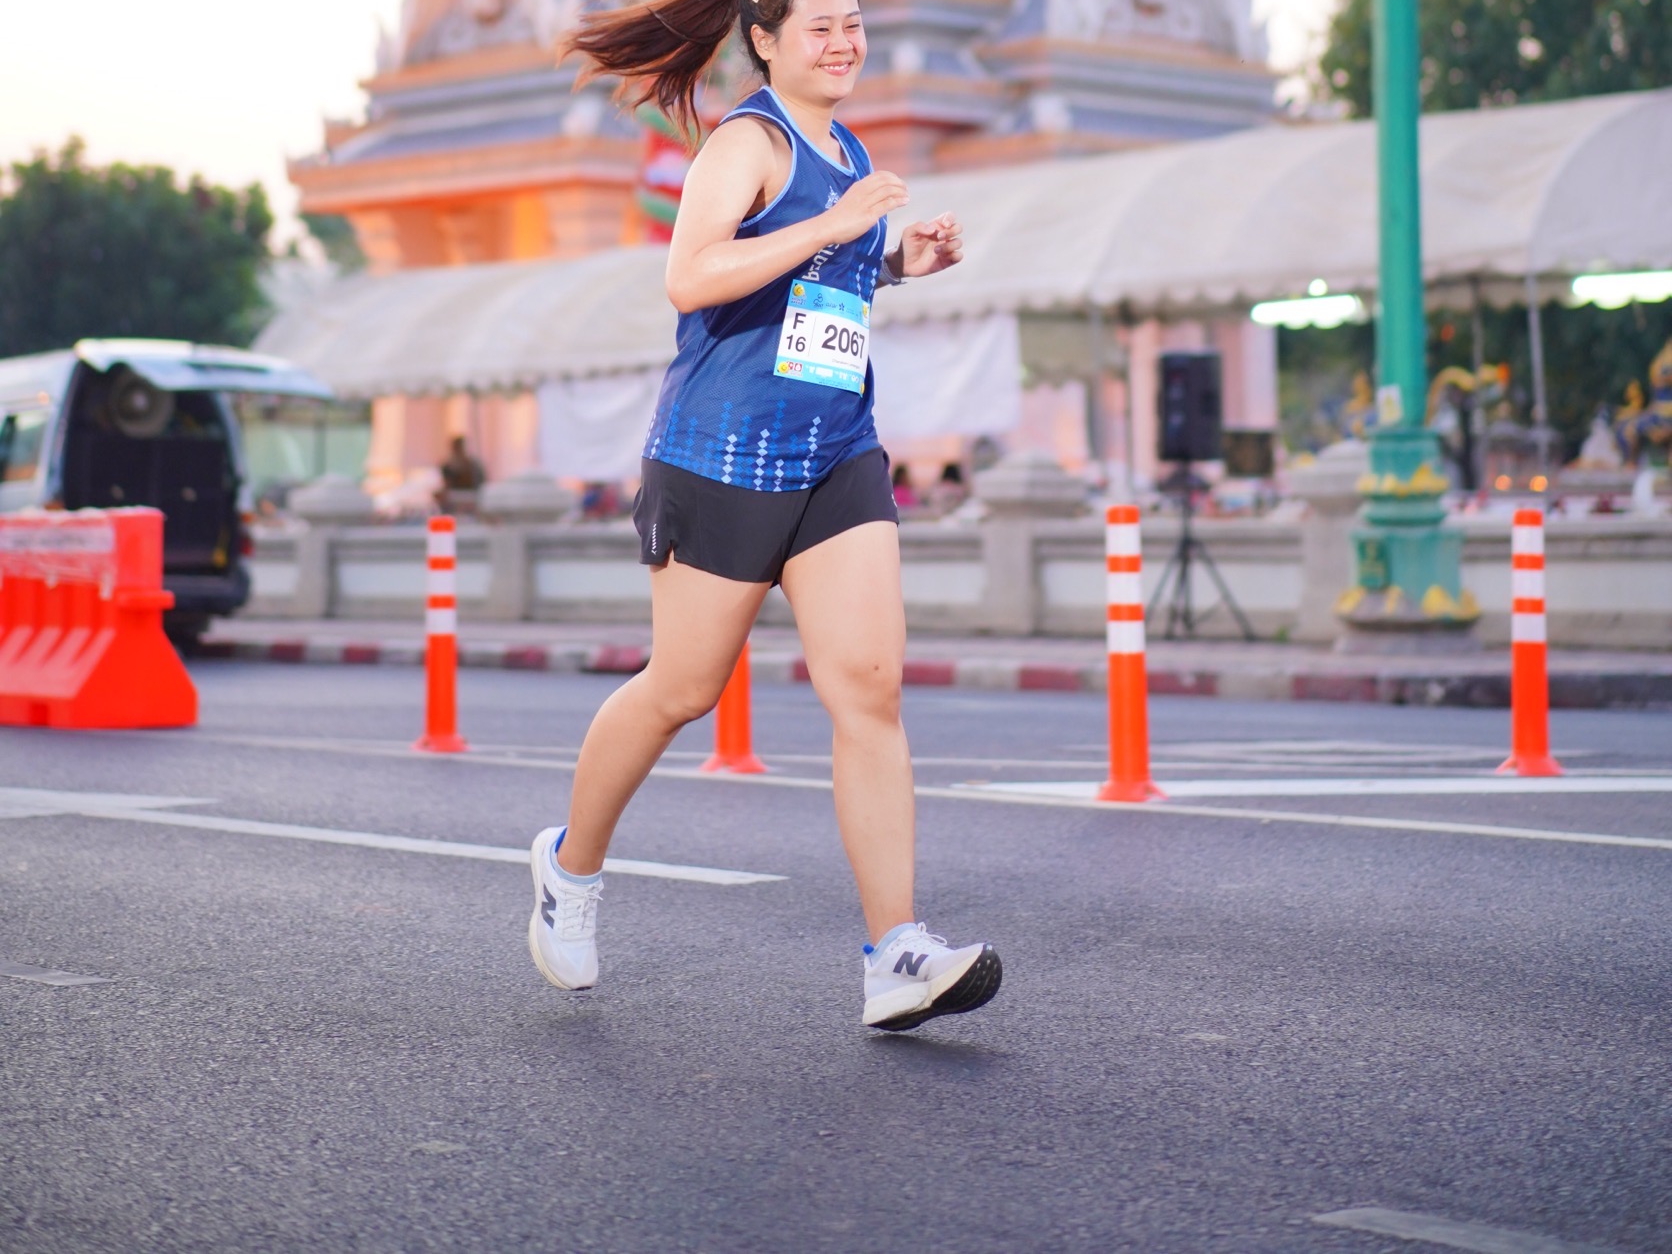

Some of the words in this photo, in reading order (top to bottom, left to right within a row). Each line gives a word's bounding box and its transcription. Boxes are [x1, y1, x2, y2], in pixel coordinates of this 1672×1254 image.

[793, 312, 806, 330] F
[786, 334, 806, 352] 16
[821, 324, 865, 359] 2067
[892, 951, 929, 976] N
